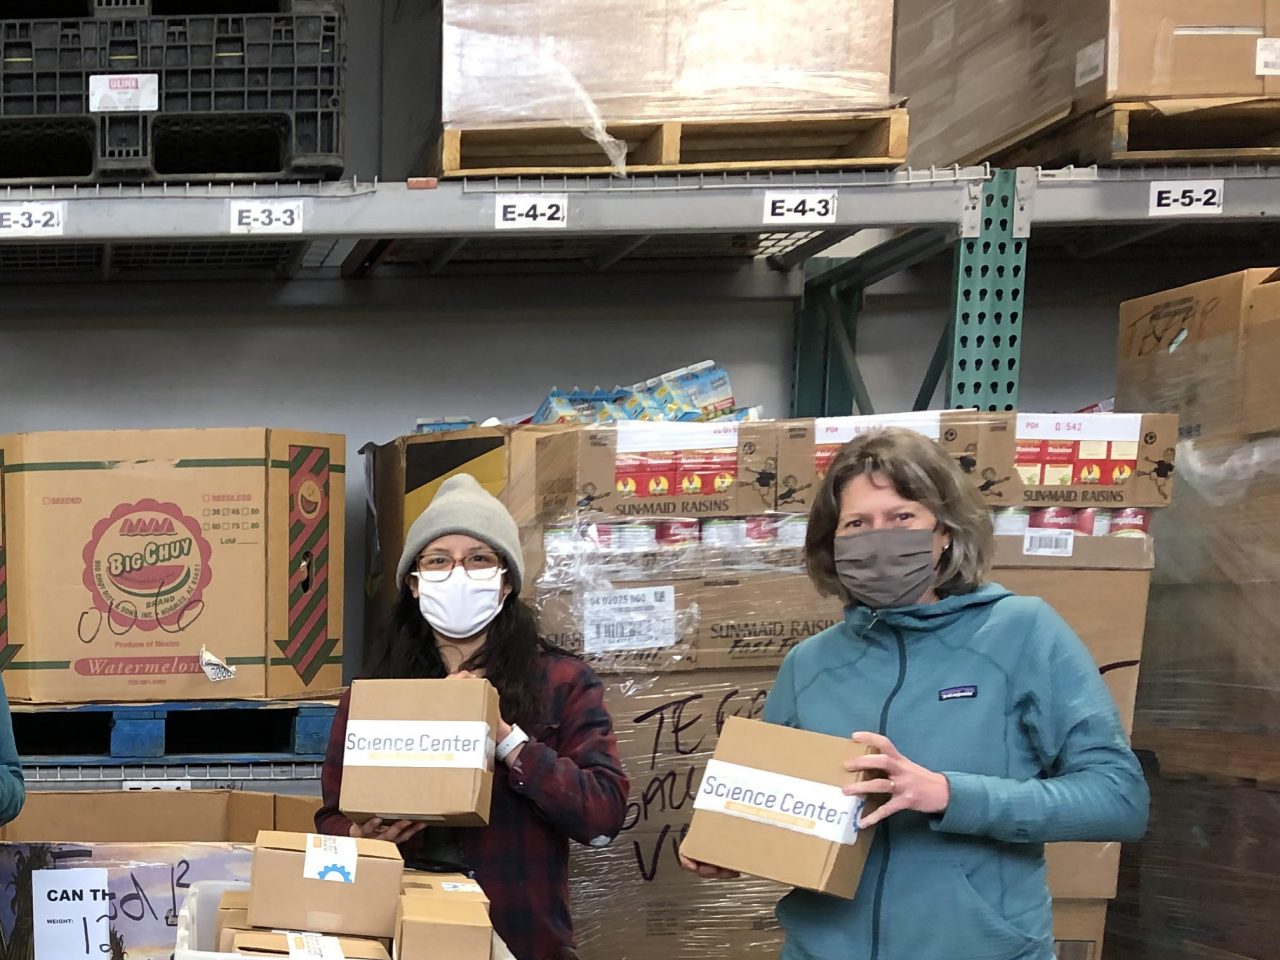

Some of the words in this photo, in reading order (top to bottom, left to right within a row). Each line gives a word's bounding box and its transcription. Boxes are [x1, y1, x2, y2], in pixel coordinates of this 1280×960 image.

[1157, 188, 1217, 207] E-5-2
[503, 204, 561, 221] E-4-2
[770, 199, 829, 216] E-4-3
[238, 209, 295, 226] E-3-3
[1082, 490, 1124, 502] RAISINS
[681, 500, 730, 513] RAISINS
[88, 657, 200, 675] Watermelon
[346, 733, 415, 751] Science
[420, 734, 480, 752] Center
[703, 776, 777, 809] Science
[780, 793, 849, 825] Center
[47, 889, 83, 901] CAN
